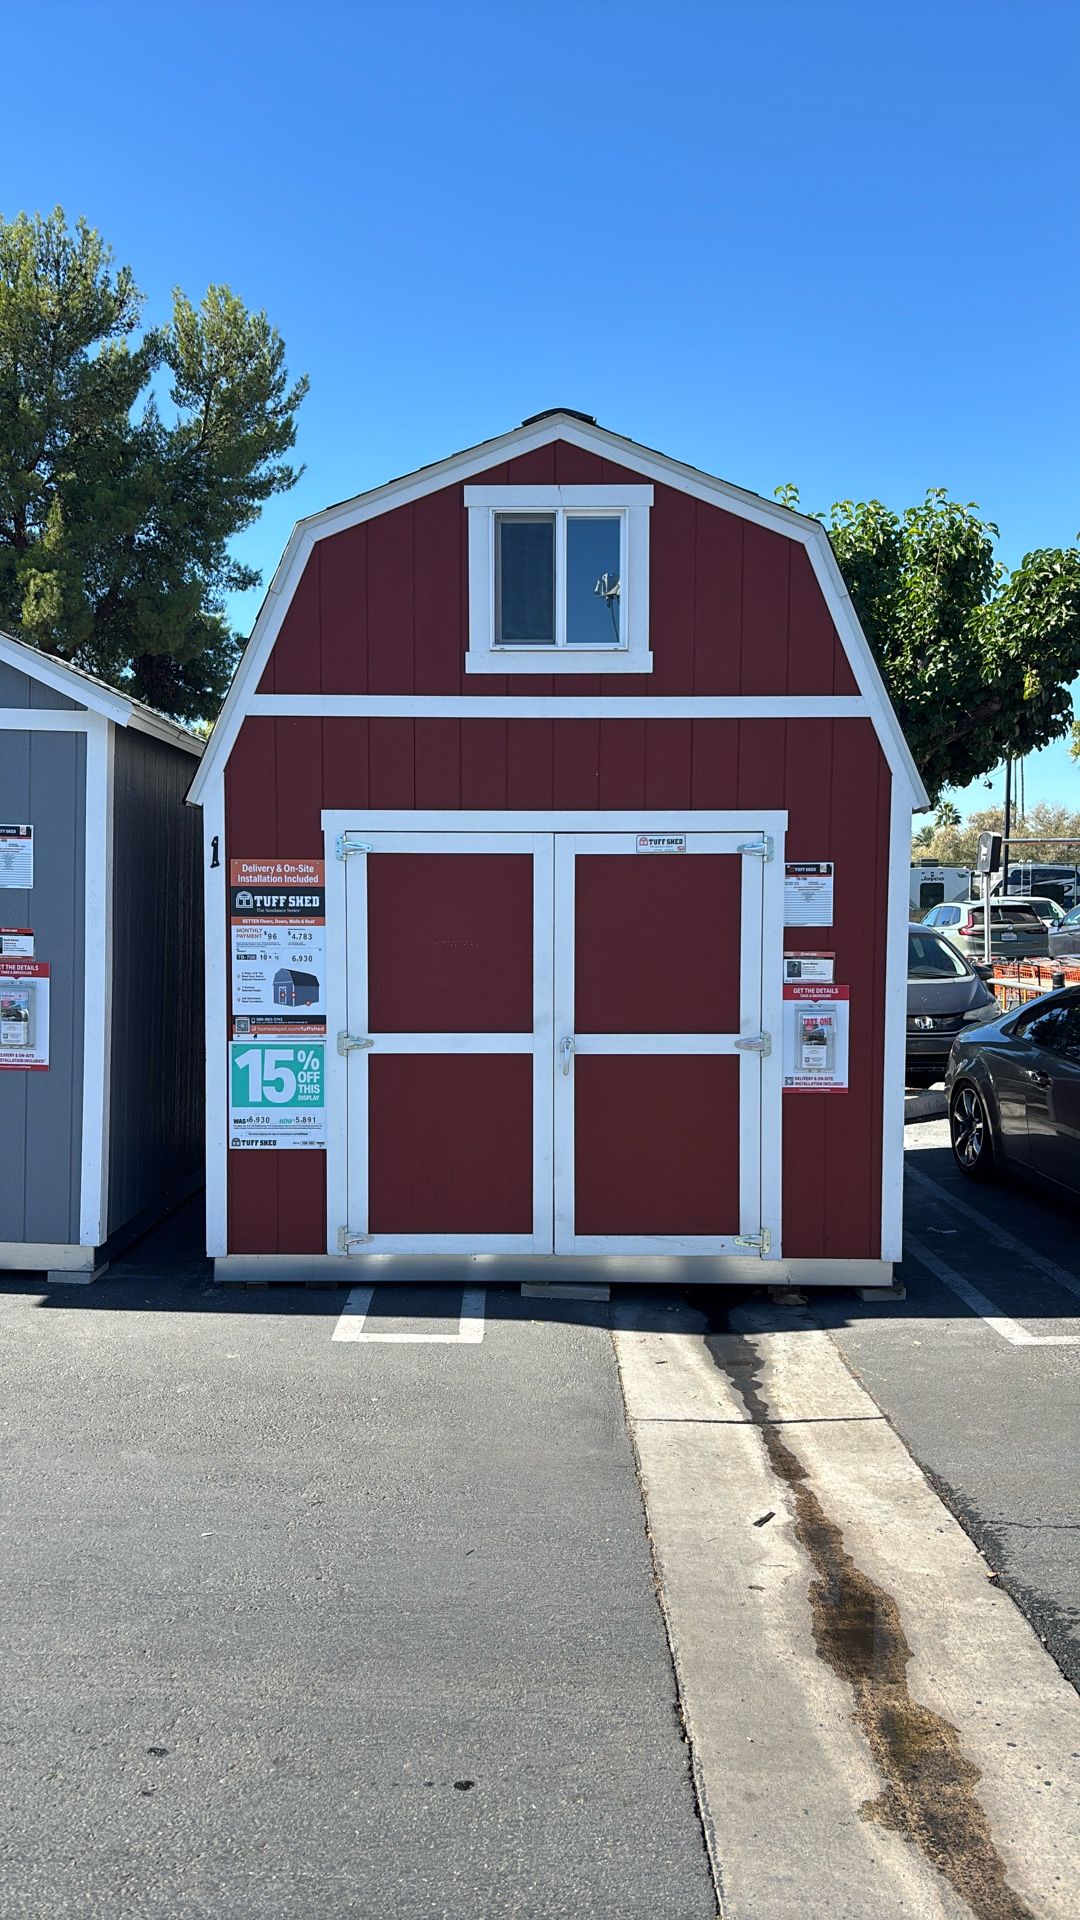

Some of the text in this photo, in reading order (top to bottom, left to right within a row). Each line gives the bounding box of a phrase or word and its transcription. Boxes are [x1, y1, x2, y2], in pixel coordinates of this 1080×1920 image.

[242, 864, 314, 874] Delivery & On-Site
[237, 874, 319, 883] Installation Included
[254, 896, 320, 907] TUFF SHED
[292, 955, 313, 963] 6,930
[298, 1072, 320, 1083] OFF
[298, 1084, 320, 1094] THIS
